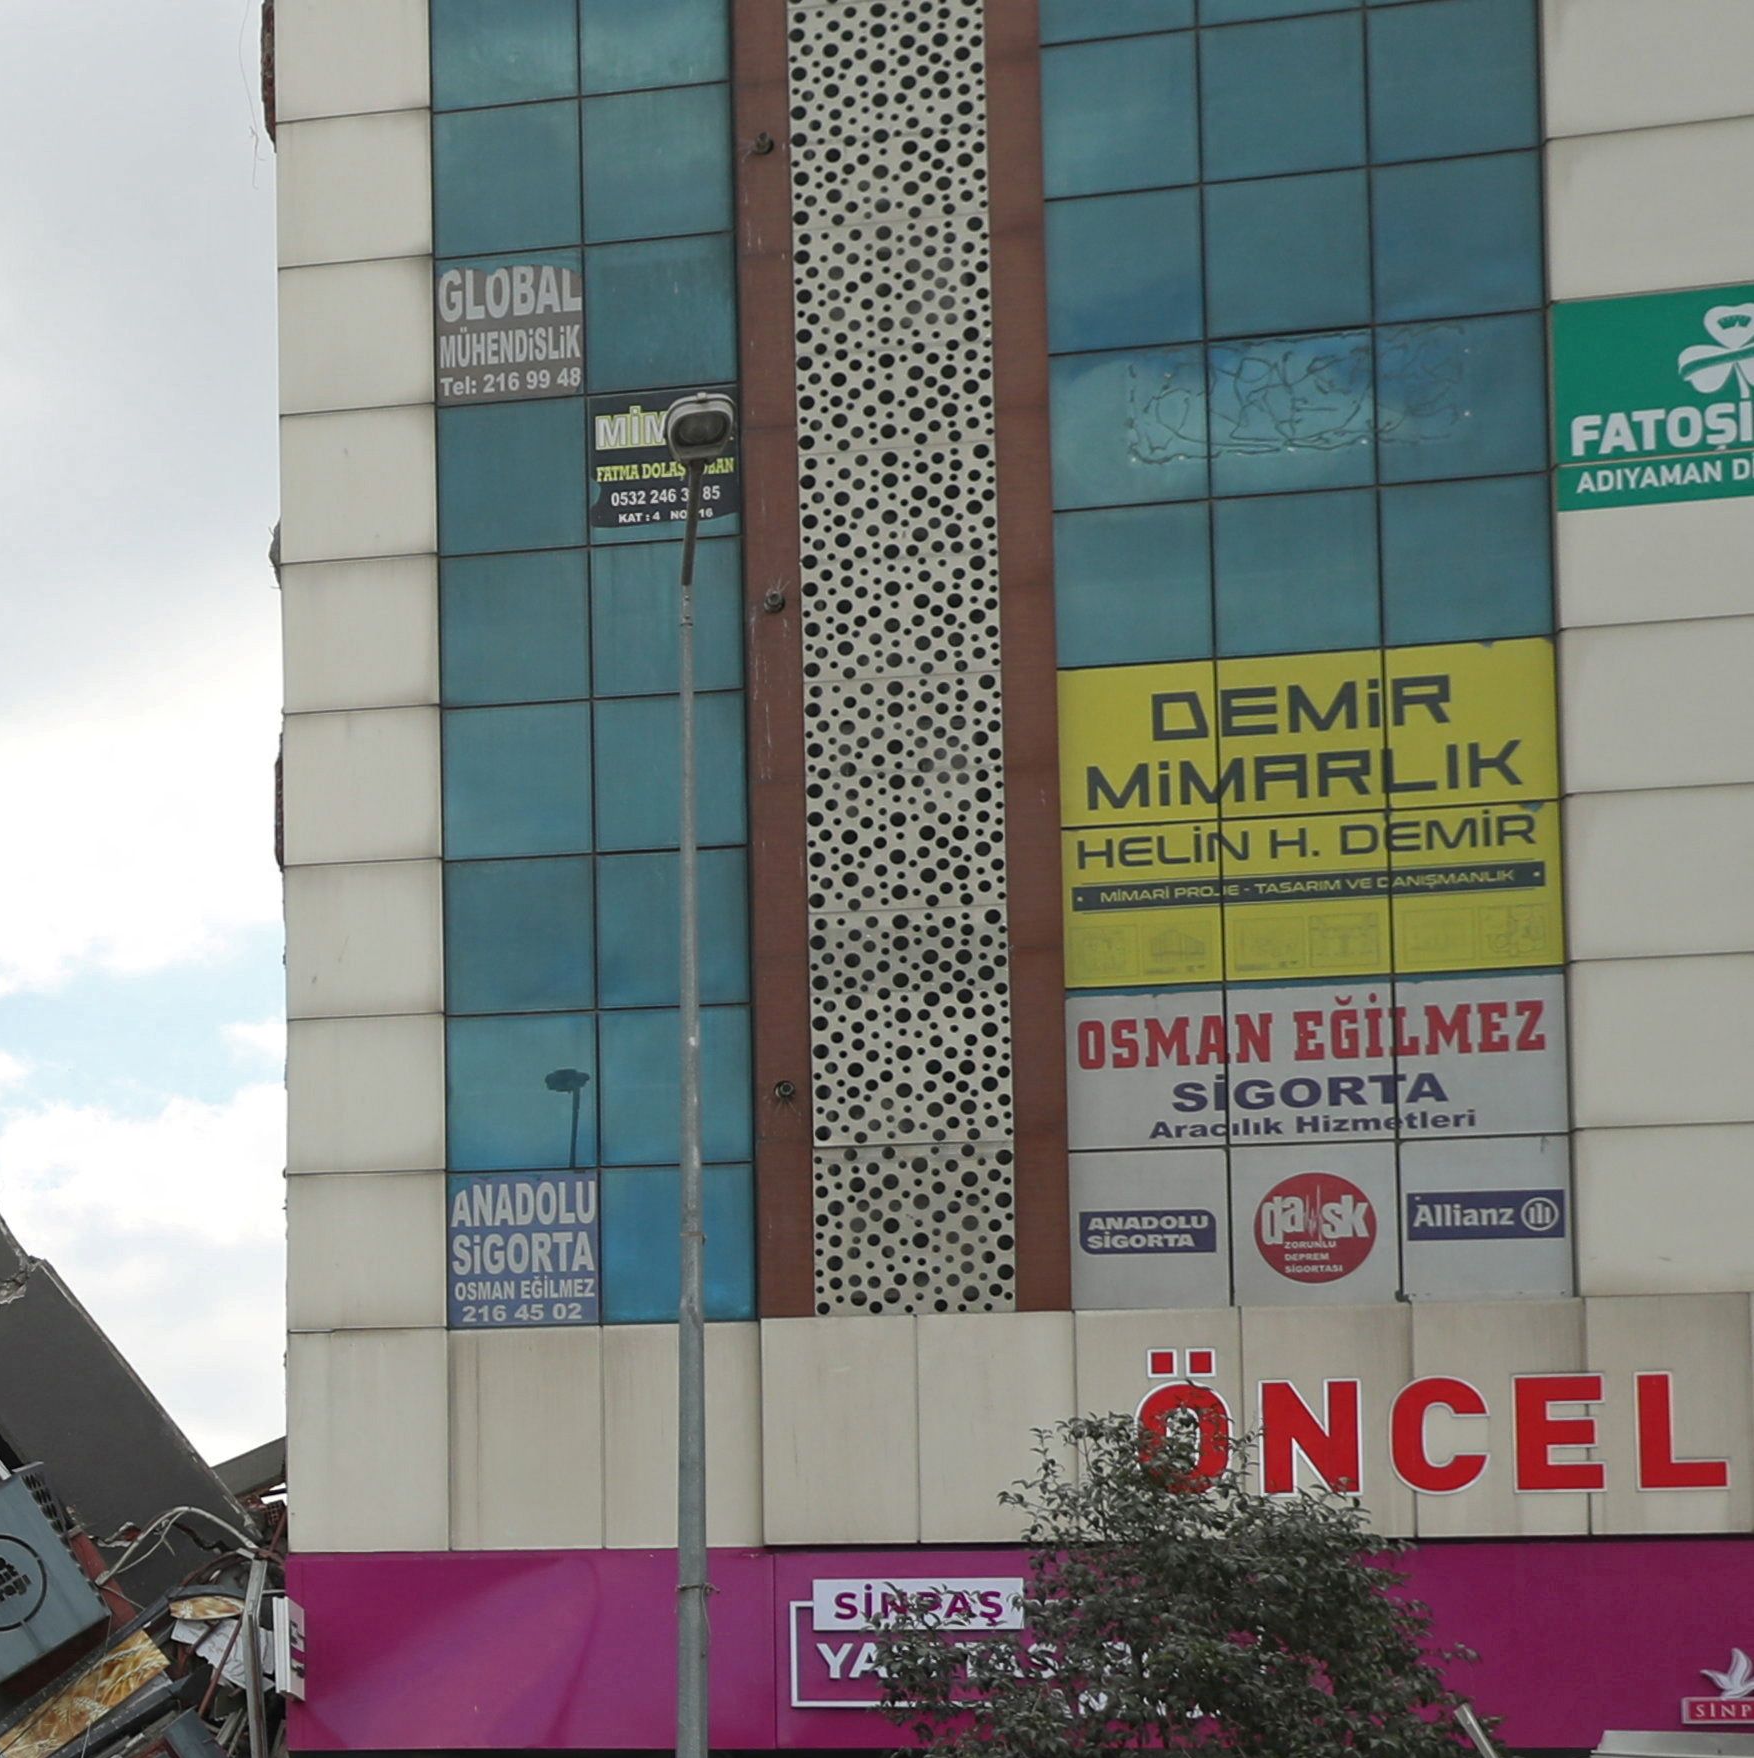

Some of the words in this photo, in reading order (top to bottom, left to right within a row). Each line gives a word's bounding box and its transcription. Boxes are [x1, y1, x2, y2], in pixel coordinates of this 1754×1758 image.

[439, 265, 582, 323] GLOBAL
[440, 377, 477, 396] Tel:
[483, 373, 520, 393] 216
[526, 370, 551, 389] 99
[557, 367, 582, 387] 48
[597, 464, 641, 483] FATMA
[642, 462, 686, 482] DOLAŞ
[1576, 460, 1722, 494] ADIYAMAN
[611, 491, 647, 507] 0532
[650, 488, 677, 504] 246
[703, 485, 721, 501] 85
[618, 512, 643, 523] KAT
[652, 511, 661, 521] 4
[699, 507, 714, 518] 16
[1268, 828, 1321, 859] H.
[1254, 879, 1341, 895] TASARIM
[1345, 876, 1373, 890] VE
[1076, 1011, 1273, 1071] OSMAN
[1293, 995, 1546, 1063] EĞİLMEZ
[1148, 1115, 1283, 1141] Aracılık
[1296, 1109, 1476, 1135] Hizmetleri
[451, 1180, 596, 1227] ANADOLU
[1412, 1201, 1515, 1229] Allianz
[1087, 1214, 1210, 1232] ANADOLU
[454, 1280, 515, 1301] OSMAN
[520, 1275, 595, 1299] EĞİLMEZ
[462, 1304, 508, 1322] 216
[514, 1303, 545, 1321] 45
[552, 1302, 583, 1320] 02
[1134, 1347, 1729, 1497] ÖNCEL
